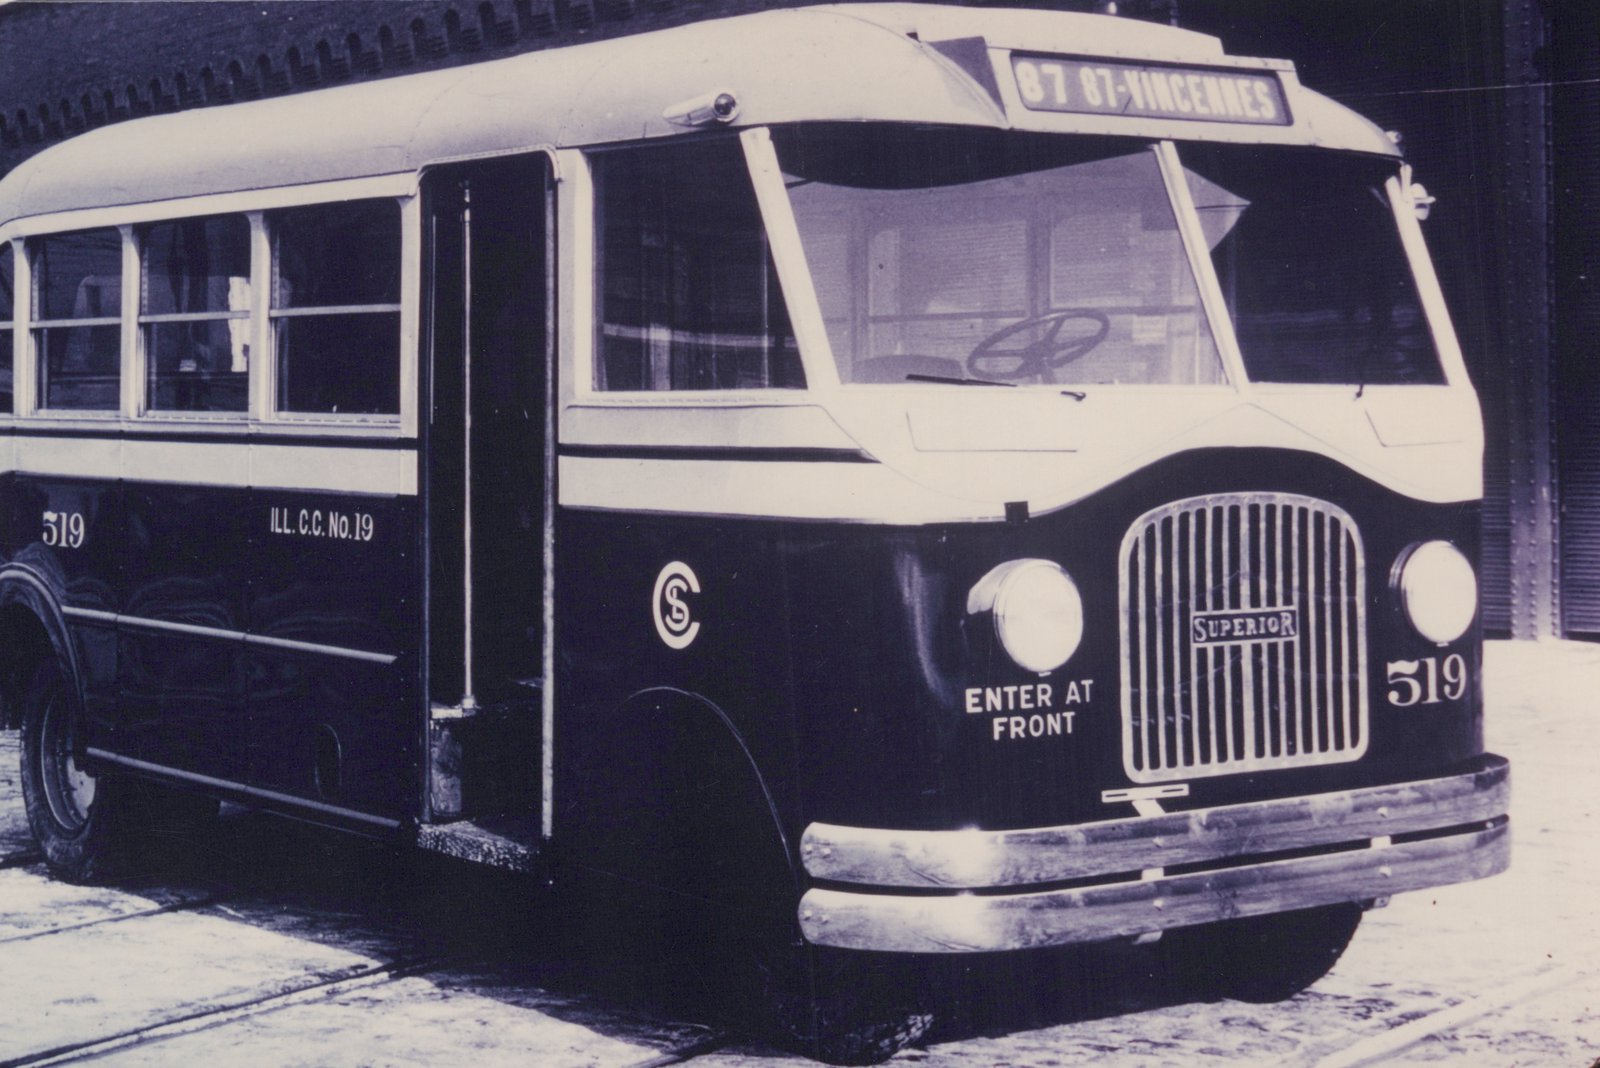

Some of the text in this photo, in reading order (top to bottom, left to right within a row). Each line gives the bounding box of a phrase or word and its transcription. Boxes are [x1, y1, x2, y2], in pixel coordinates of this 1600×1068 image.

[1015, 61, 1068, 105] 87
[42, 510, 85, 549] 519
[270, 507, 296, 534] ILL.
[965, 679, 1094, 713] ENTER AT
[1386, 653, 1467, 707] 519
[993, 711, 1076, 741] FRONT
